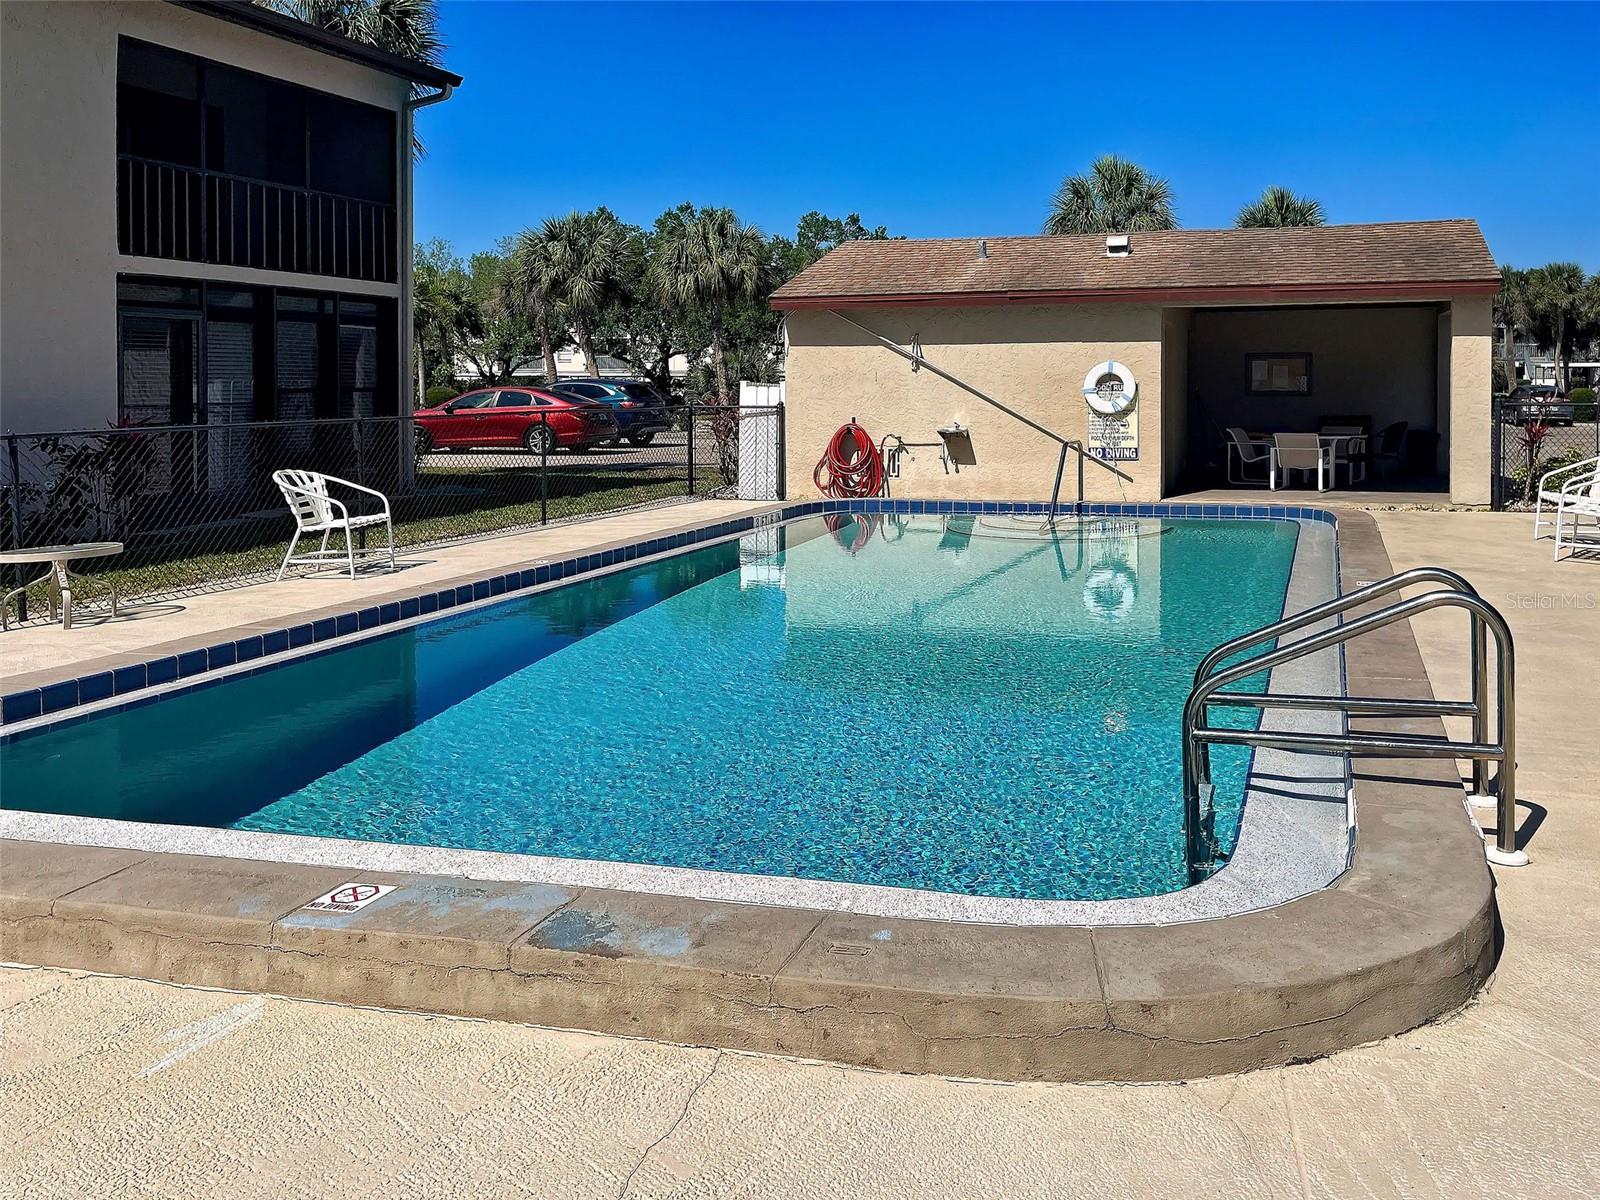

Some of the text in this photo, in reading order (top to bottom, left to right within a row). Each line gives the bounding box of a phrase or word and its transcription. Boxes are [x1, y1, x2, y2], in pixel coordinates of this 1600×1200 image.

[1090, 448, 1137, 458] NO DIVING
[323, 903, 359, 911] DIVING
